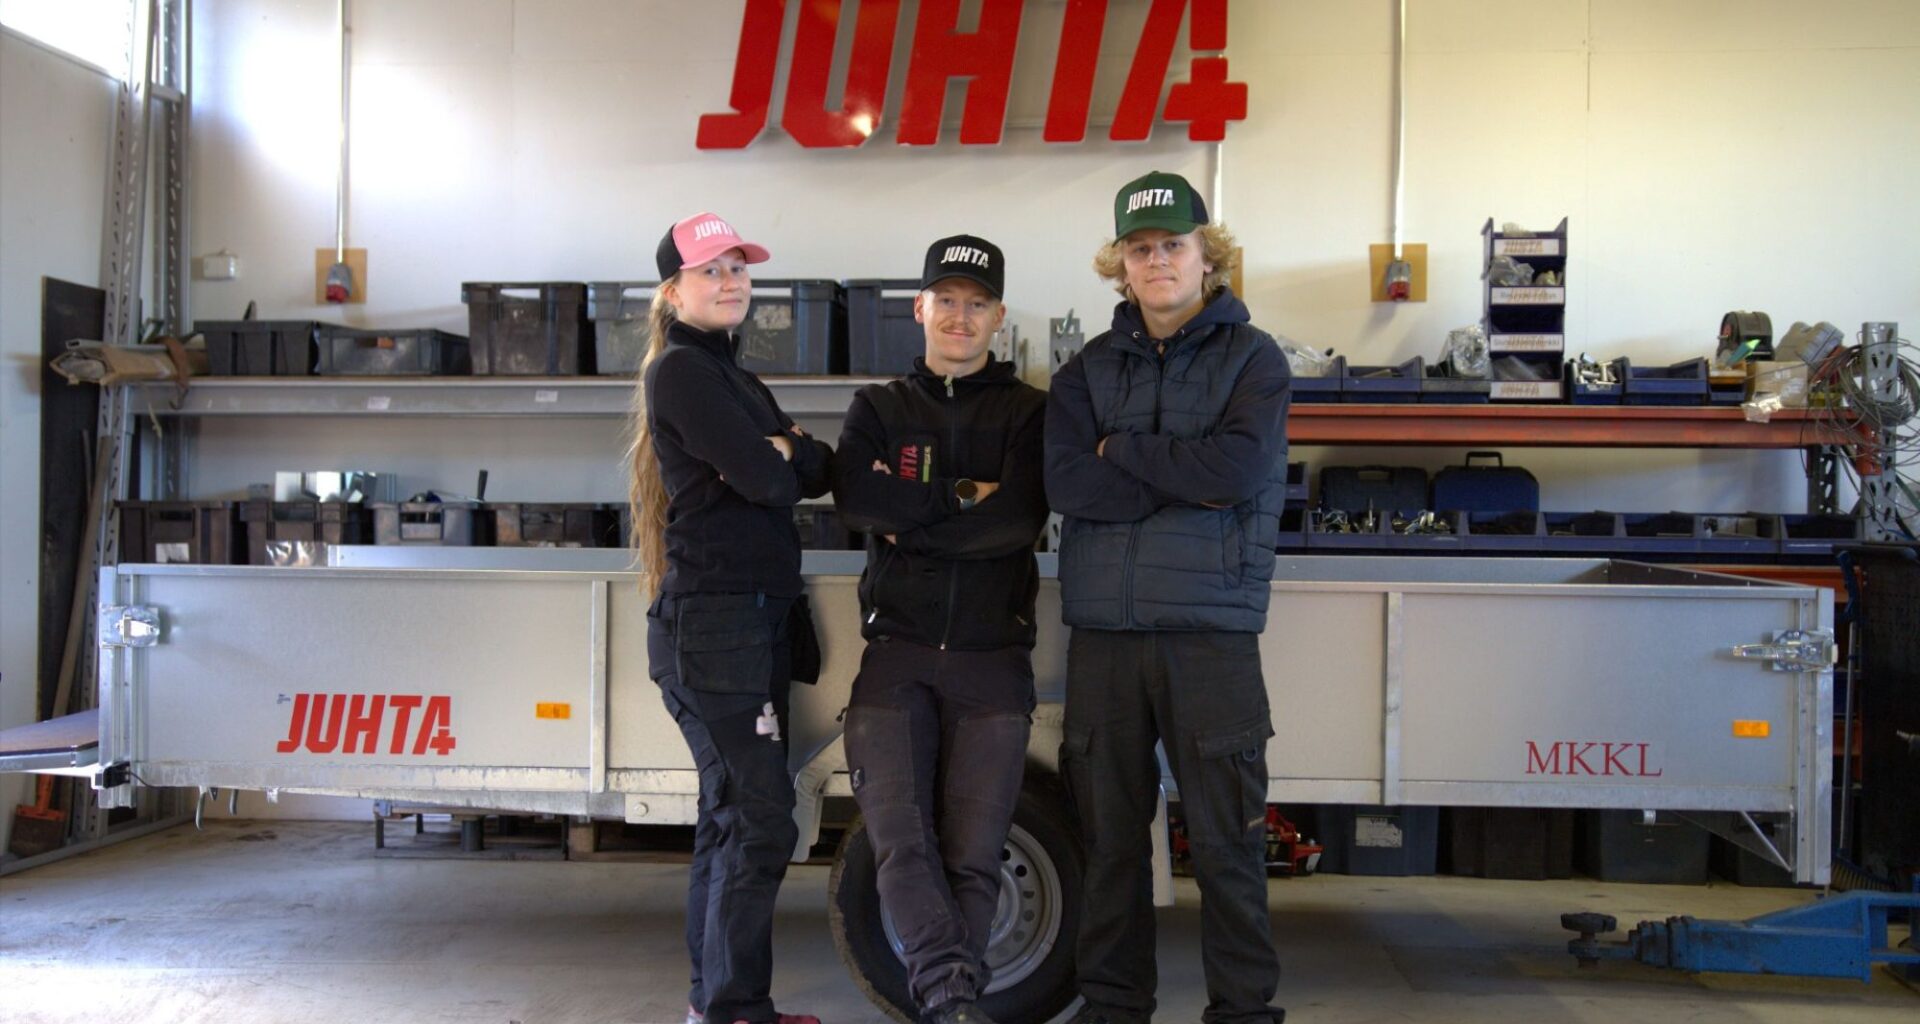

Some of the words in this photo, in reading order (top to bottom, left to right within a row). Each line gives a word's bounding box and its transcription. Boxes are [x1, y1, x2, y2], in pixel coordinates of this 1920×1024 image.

[1126, 188, 1175, 214] JUHTA
[940, 245, 989, 269] JUHTA
[900, 444, 918, 481] HTA
[277, 693, 456, 756] JUHTA
[1525, 741, 1663, 777] MKKL
